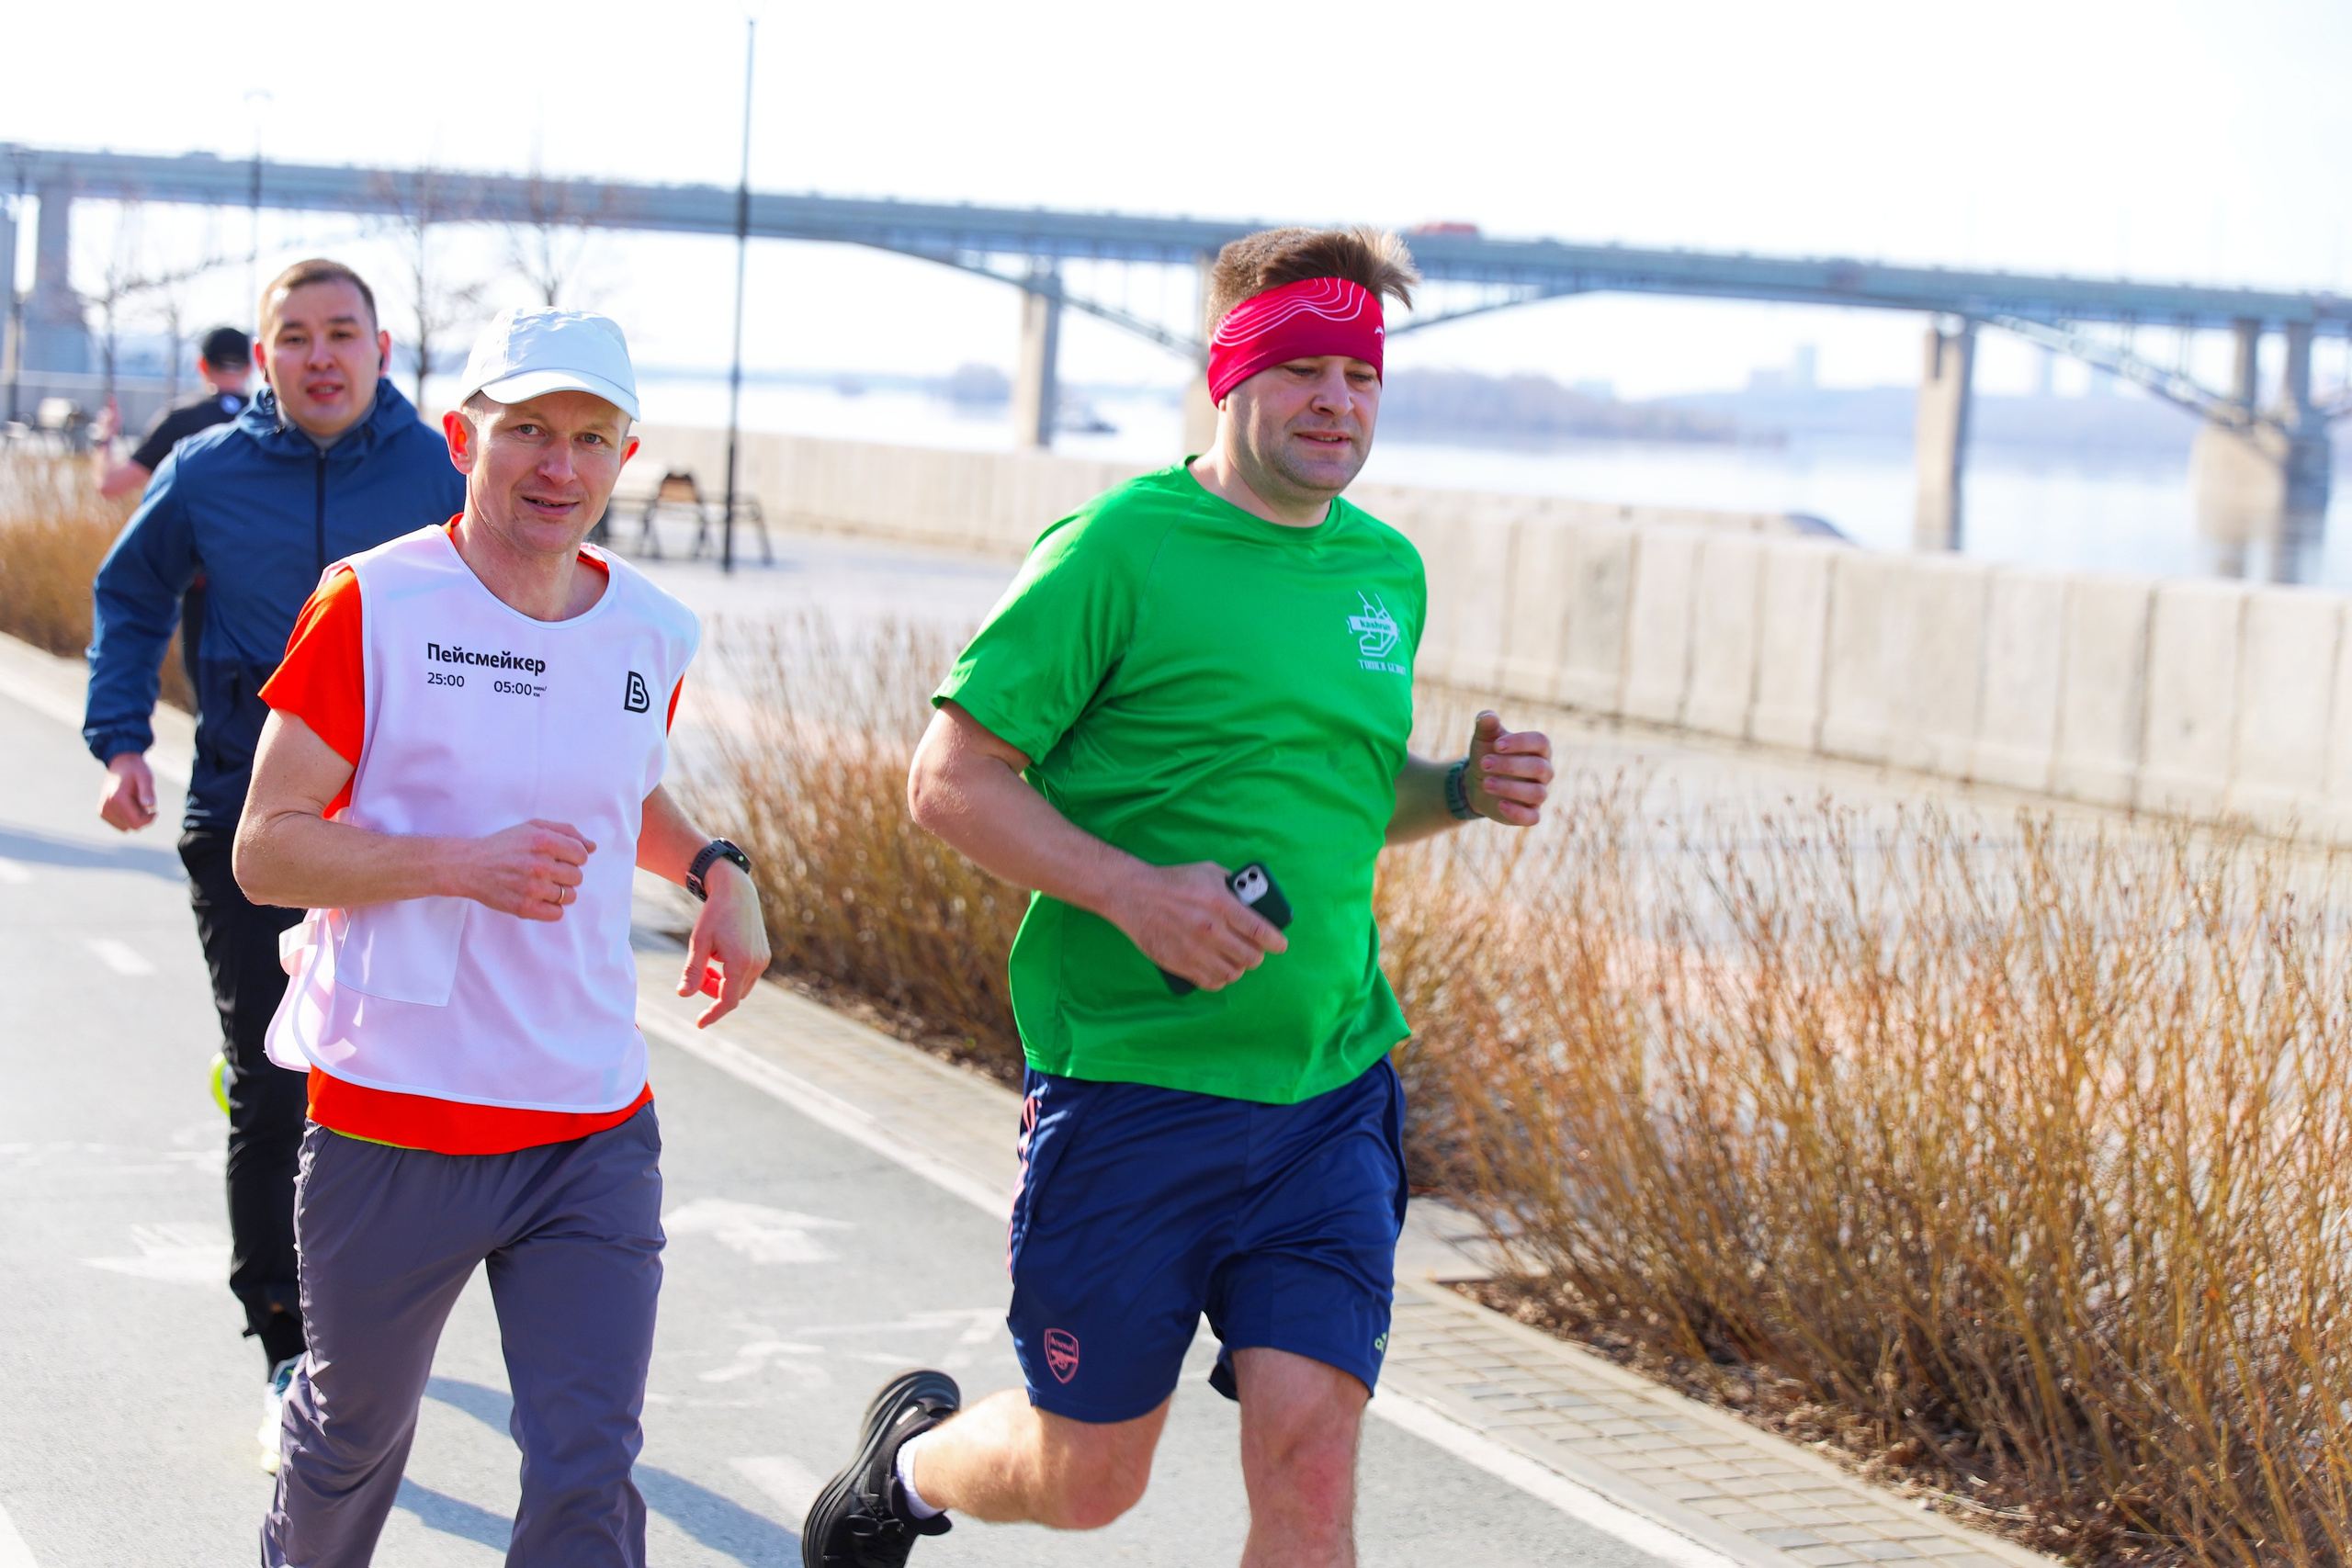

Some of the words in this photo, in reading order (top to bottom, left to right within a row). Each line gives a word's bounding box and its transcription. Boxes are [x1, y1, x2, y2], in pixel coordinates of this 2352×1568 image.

[427, 642, 546, 676] Пейсмейкер
[427, 671, 465, 687] 25:00
[493, 681, 532, 695] 05:00
